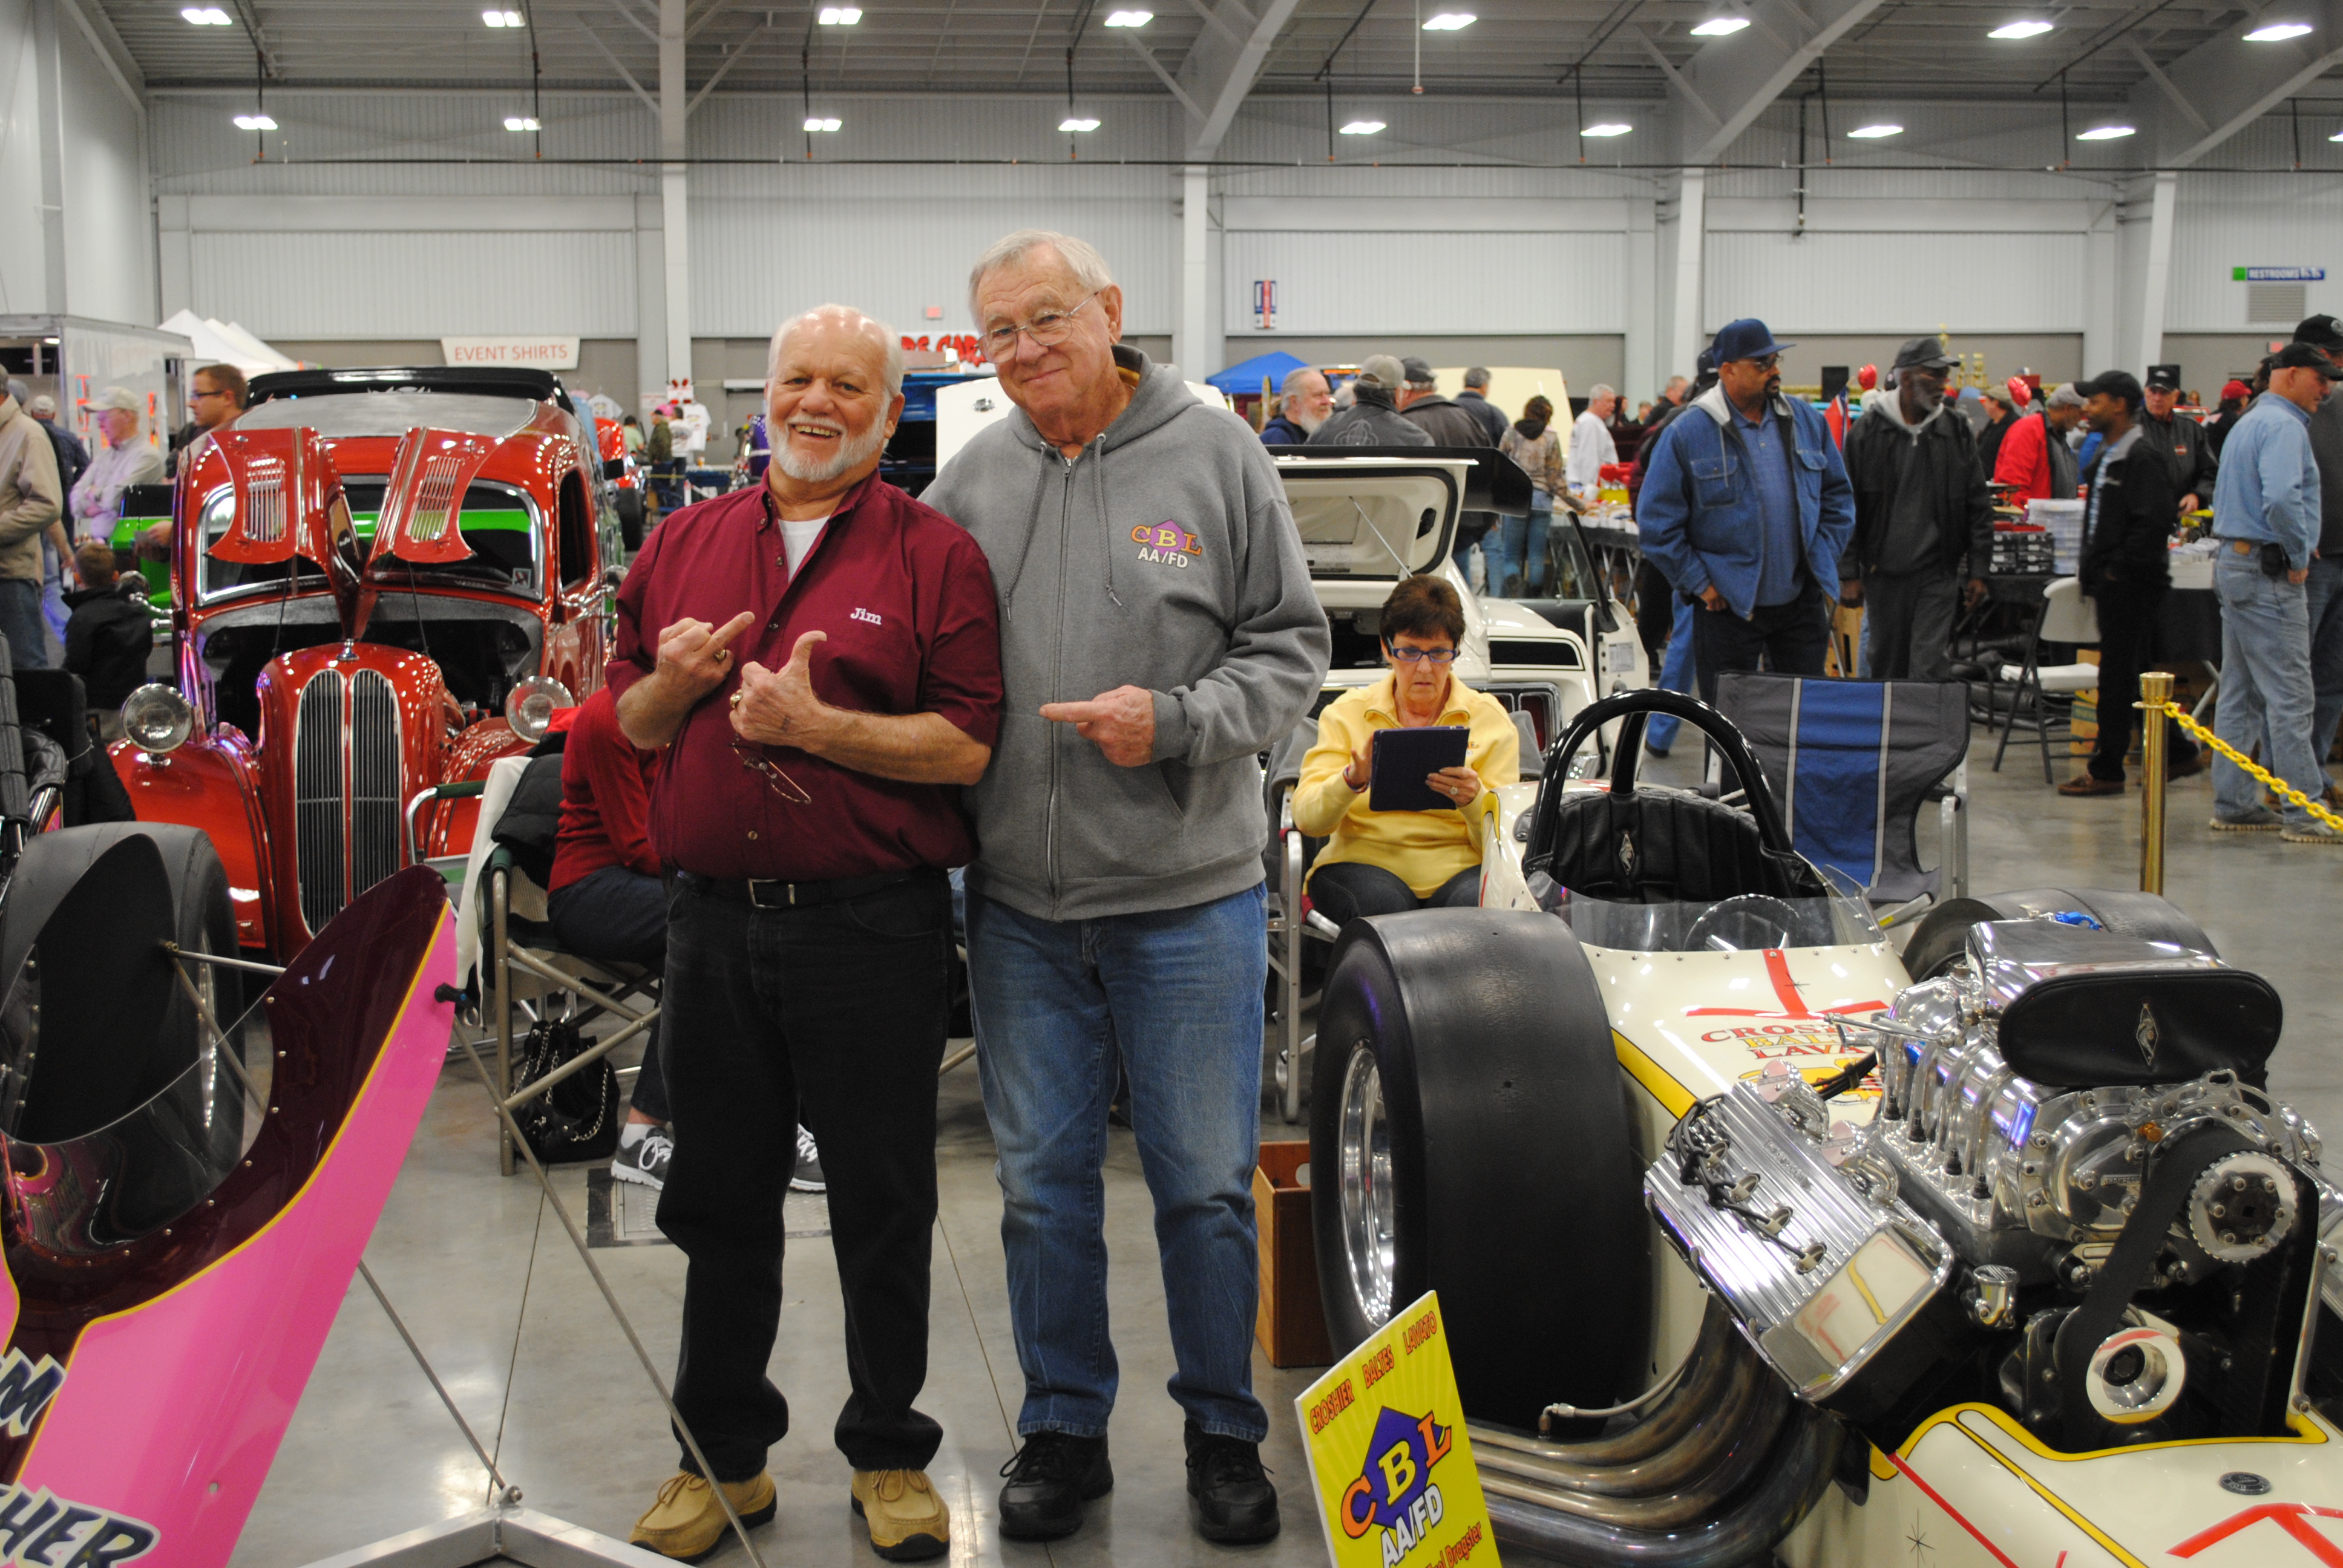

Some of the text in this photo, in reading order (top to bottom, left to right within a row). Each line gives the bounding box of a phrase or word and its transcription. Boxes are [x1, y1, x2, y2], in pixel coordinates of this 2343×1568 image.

[454, 344, 568, 362] EVENT SHIRTS
[1130, 524, 1202, 557] CBL
[1137, 546, 1188, 568] AA/FD
[850, 607, 882, 625] Jim
[1310, 1311, 1437, 1434] CROSHIER BALTES LAVATO
[1341, 1410, 1452, 1540] CBL
[1380, 1483, 1443, 1568] AA/FD
[1444, 1521, 1483, 1568] Dragster
